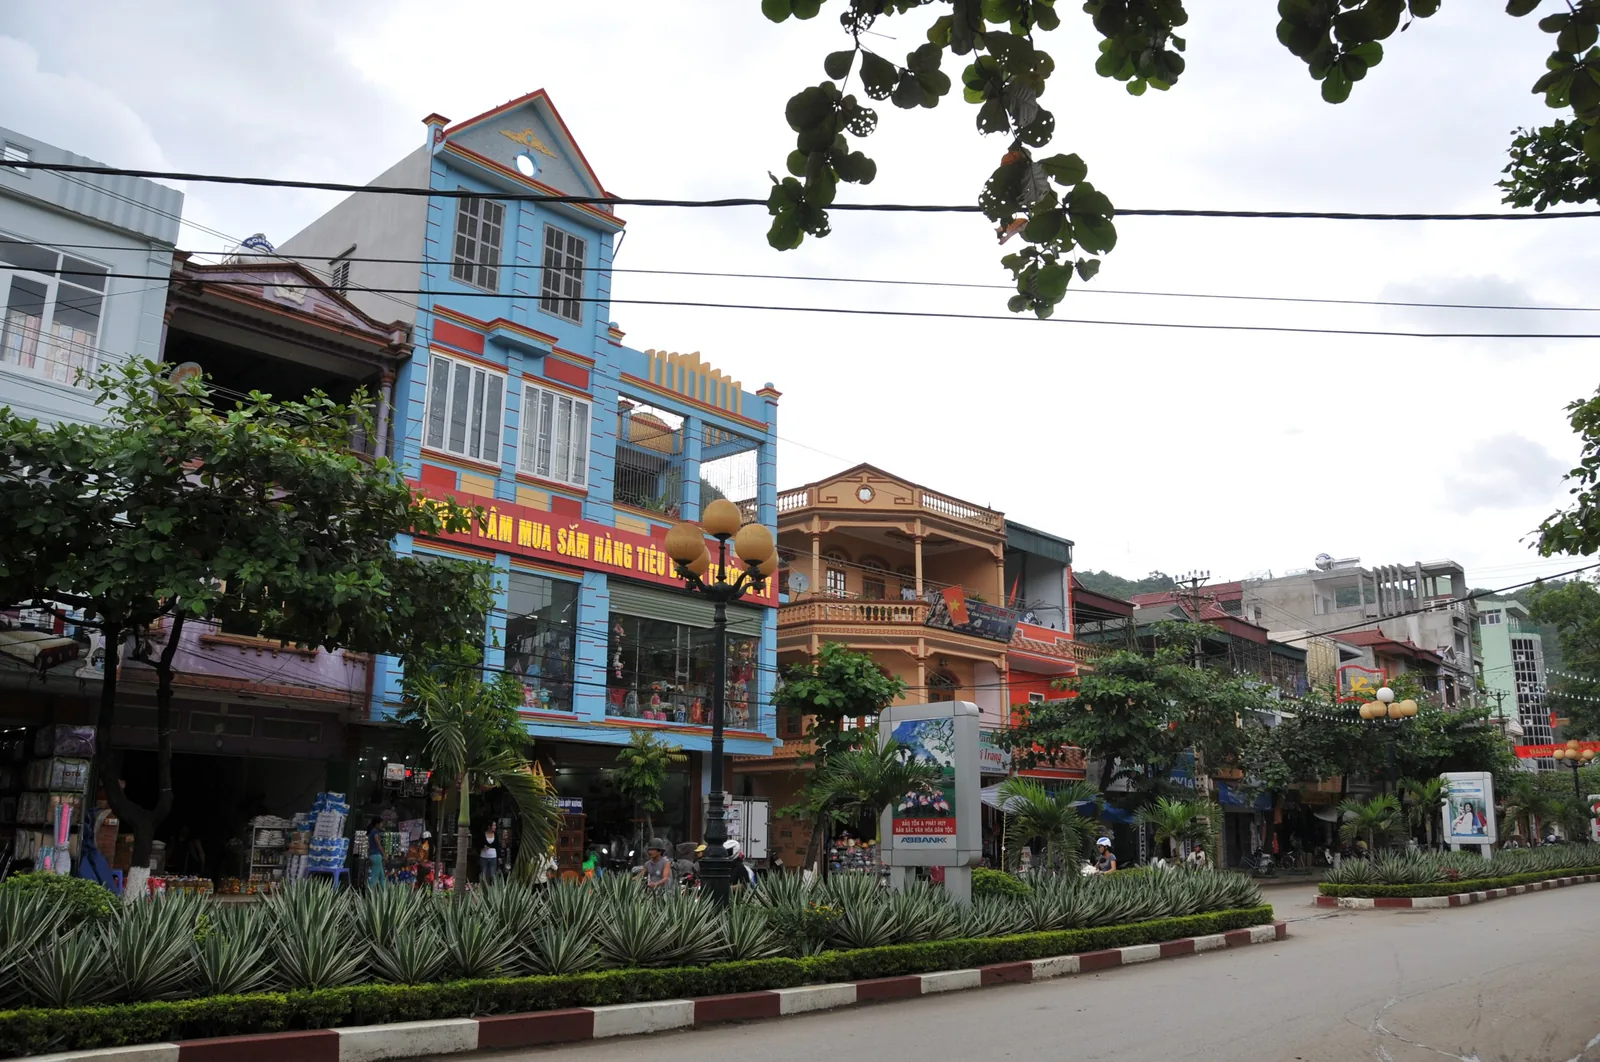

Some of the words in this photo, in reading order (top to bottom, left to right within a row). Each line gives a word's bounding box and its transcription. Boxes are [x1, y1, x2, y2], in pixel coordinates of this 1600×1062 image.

[518, 518, 552, 552] MUA
[556, 524, 590, 560] SẮM
[593, 532, 632, 570] HÀNG
[636, 543, 666, 577] TIÊU
